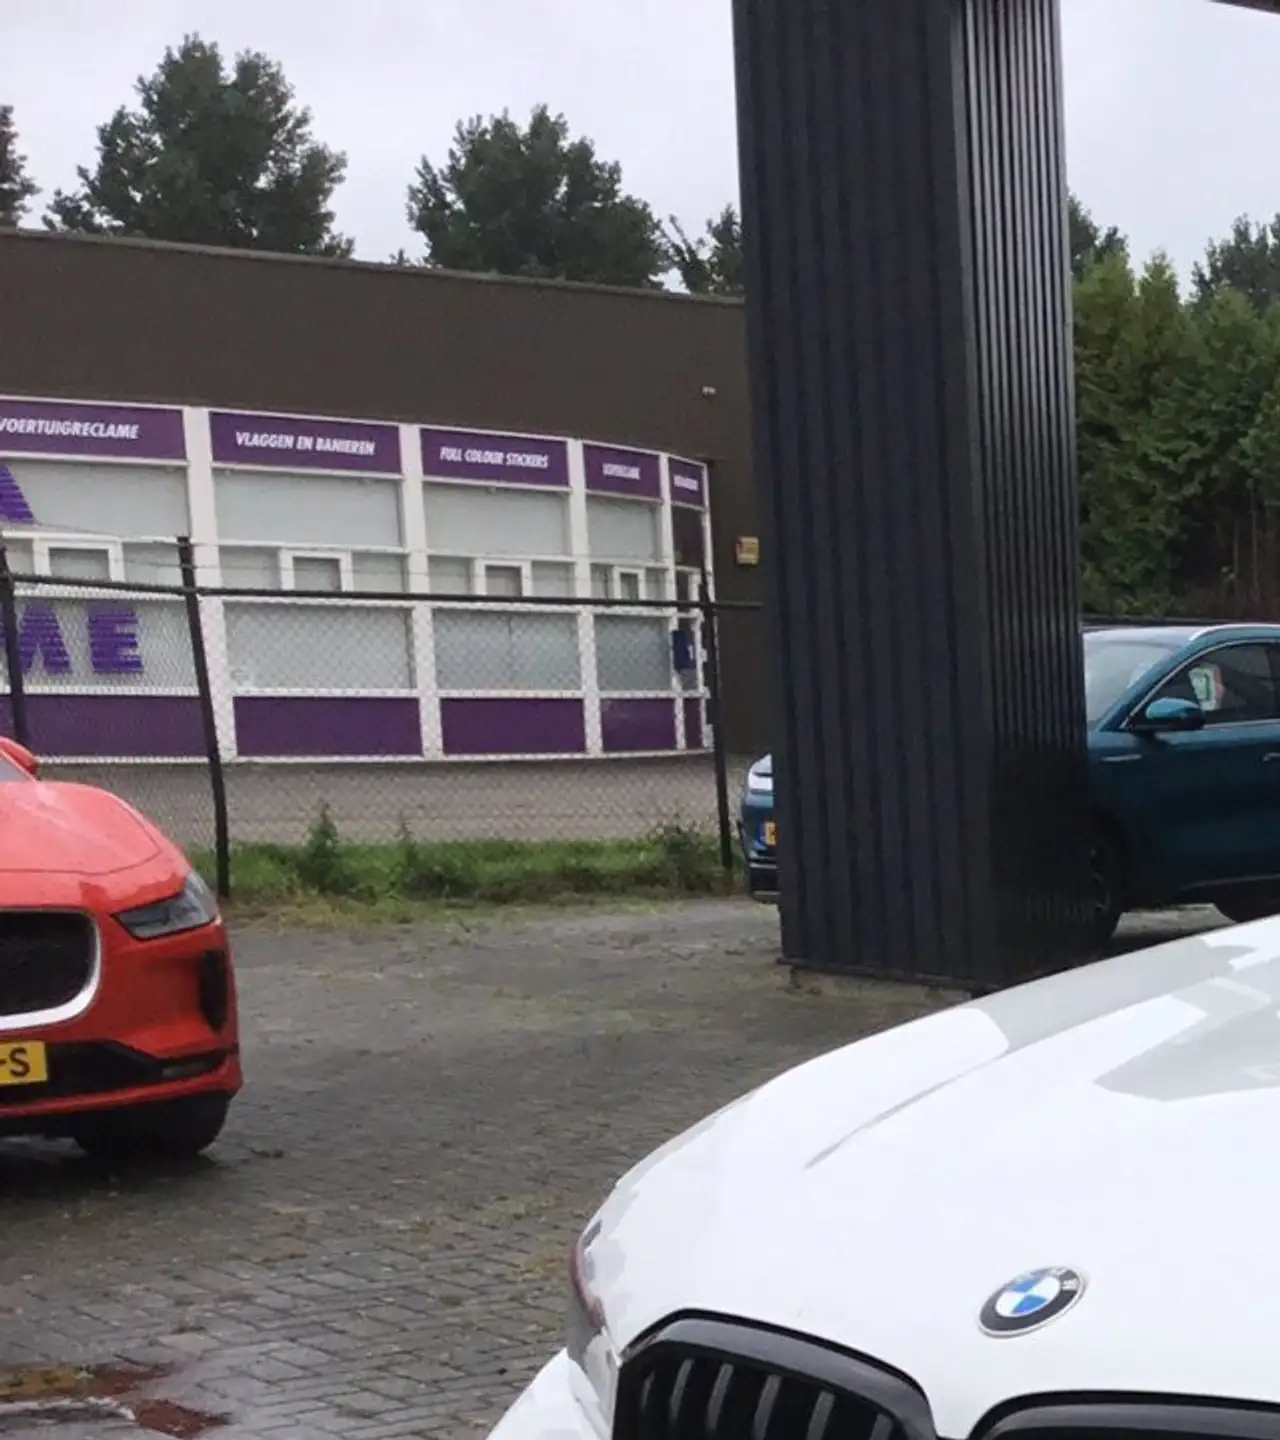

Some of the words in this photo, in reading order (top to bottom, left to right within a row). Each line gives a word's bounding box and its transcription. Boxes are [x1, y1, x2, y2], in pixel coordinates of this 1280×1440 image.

[0, 418, 140, 440] VOERTUIGRECLAME
[235, 431, 294, 448] VLAGGEN
[296, 435, 314, 451] EN
[315, 437, 376, 456] BANIEREN
[440, 446, 463, 462] FULL
[464, 448, 505, 465] COLOUR
[506, 452, 549, 469] STICKERS
